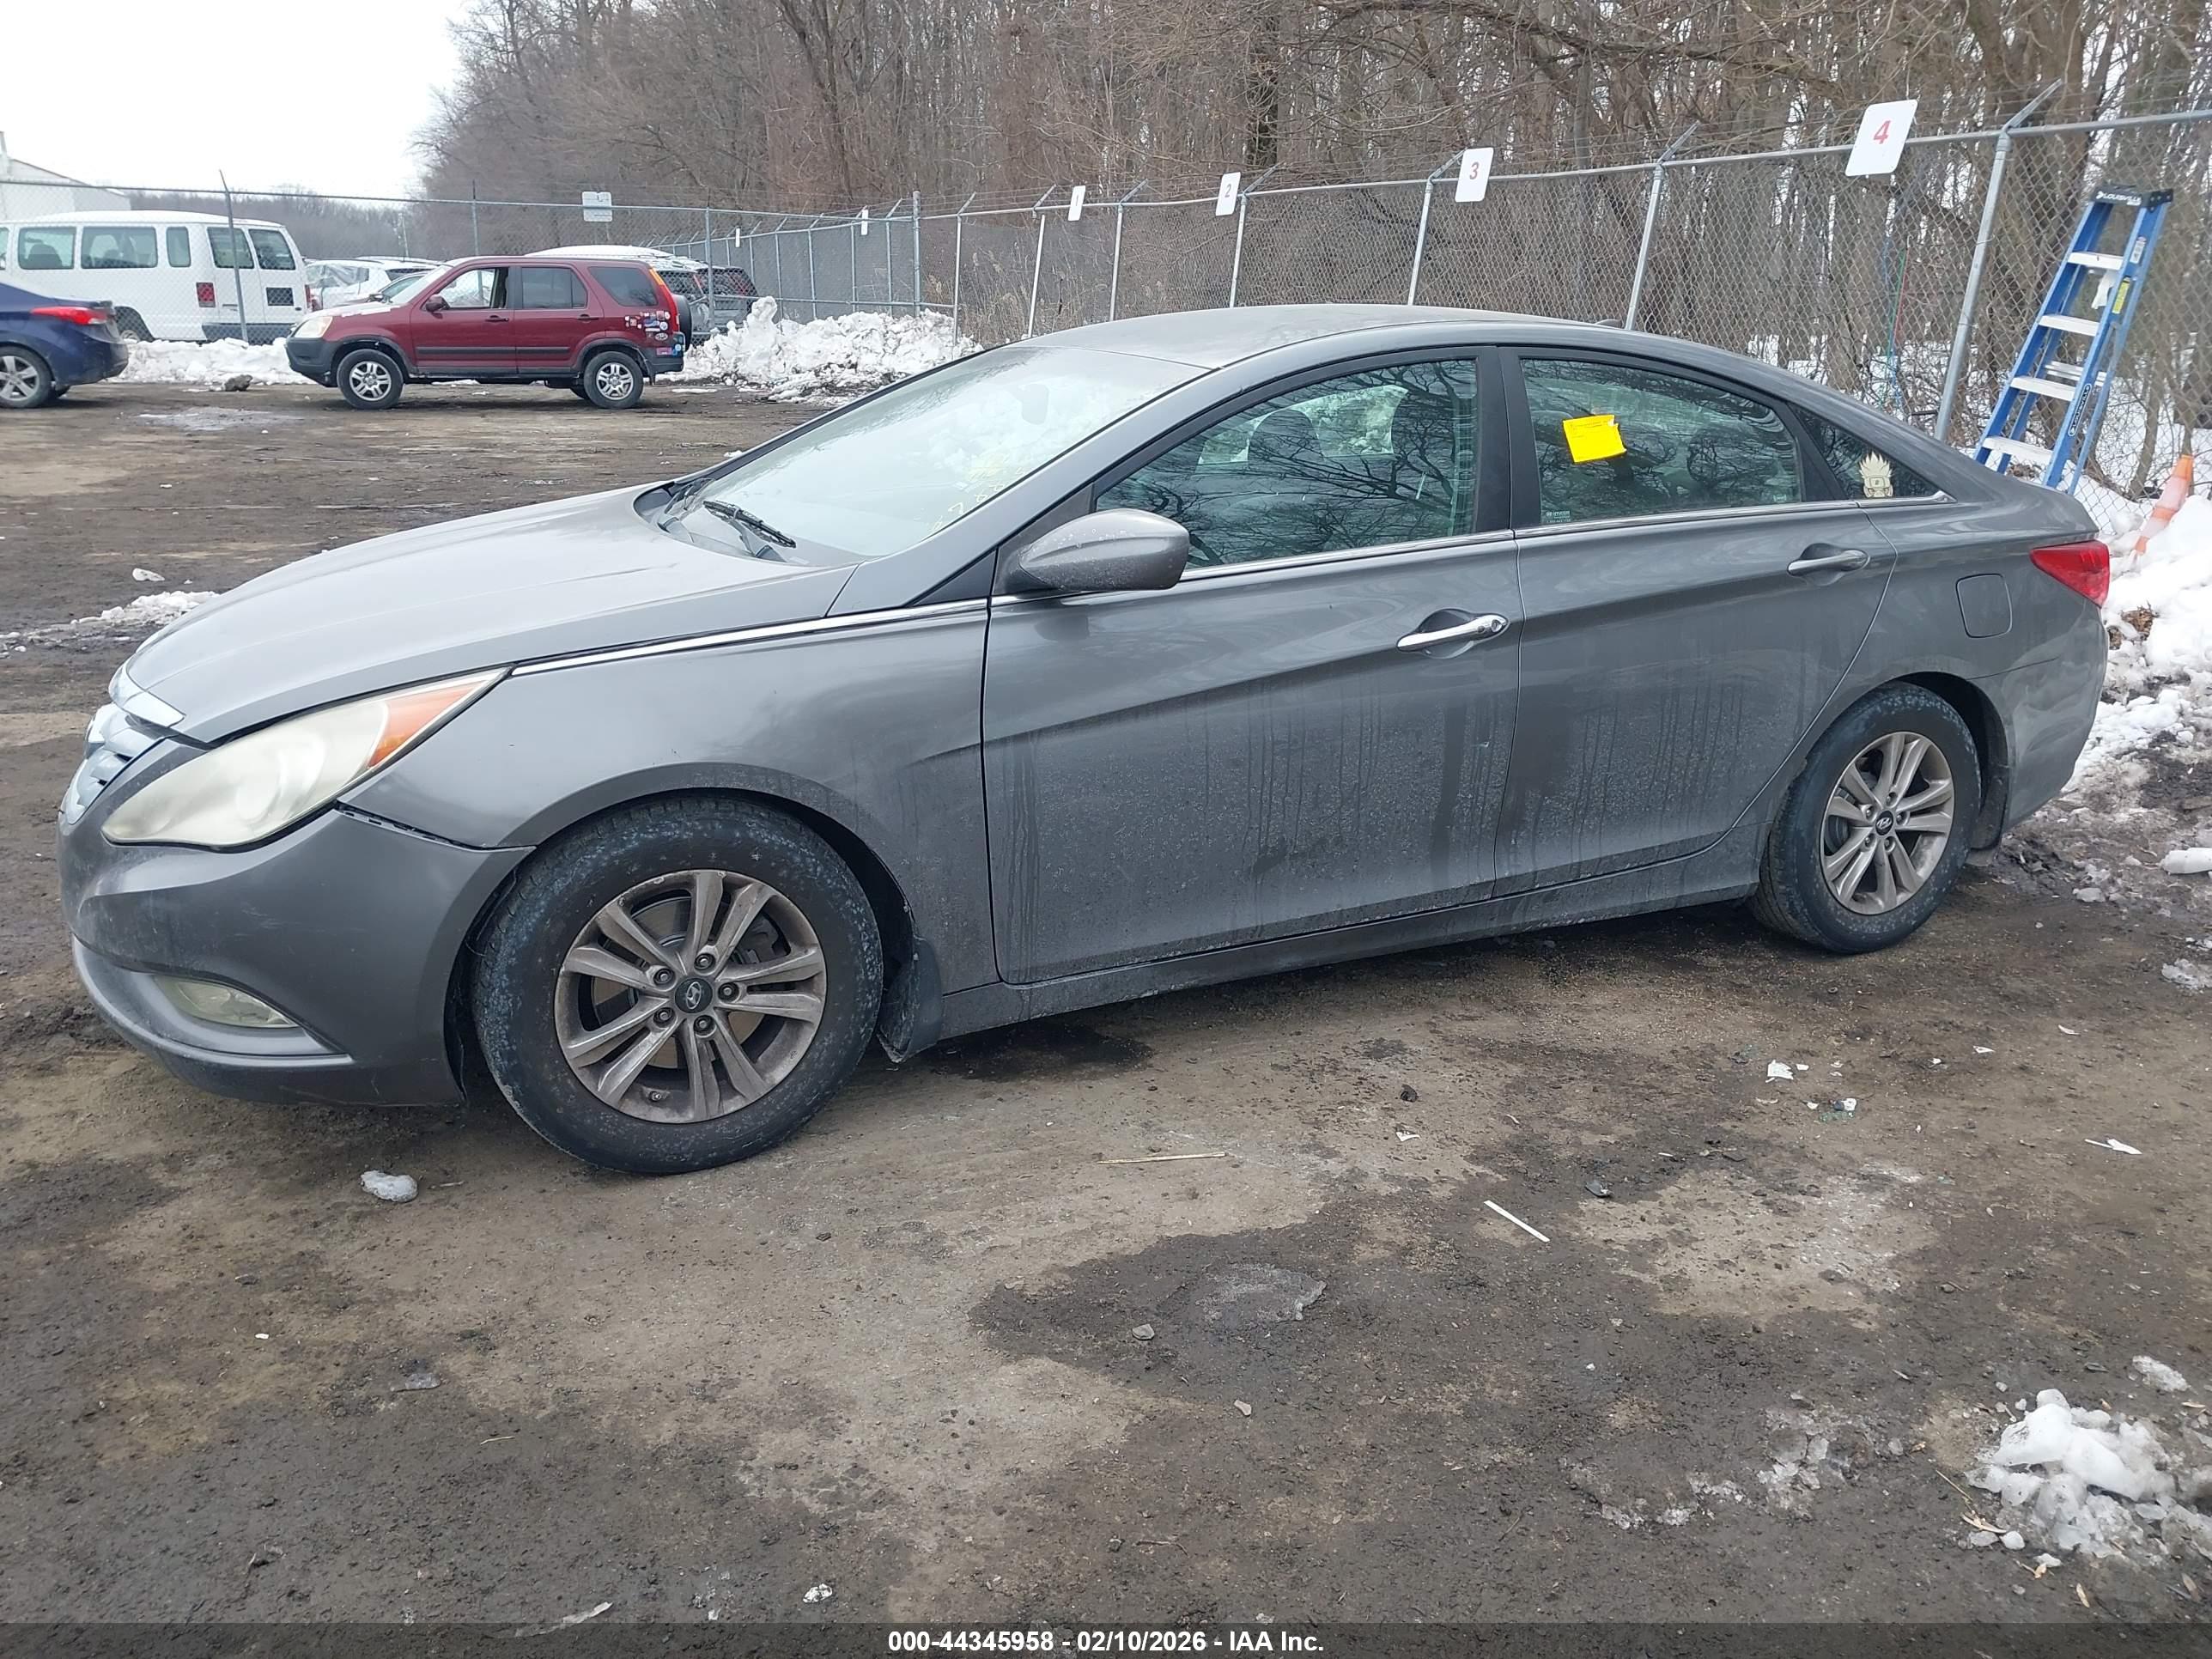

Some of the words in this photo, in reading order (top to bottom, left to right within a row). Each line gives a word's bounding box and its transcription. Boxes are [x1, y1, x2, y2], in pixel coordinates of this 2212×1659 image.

[1873, 119, 1892, 145] 4
[1469, 161, 1480, 180] 3
[1224, 183, 1231, 198] 2
[2103, 192, 2142, 203] LOUISVILLE
